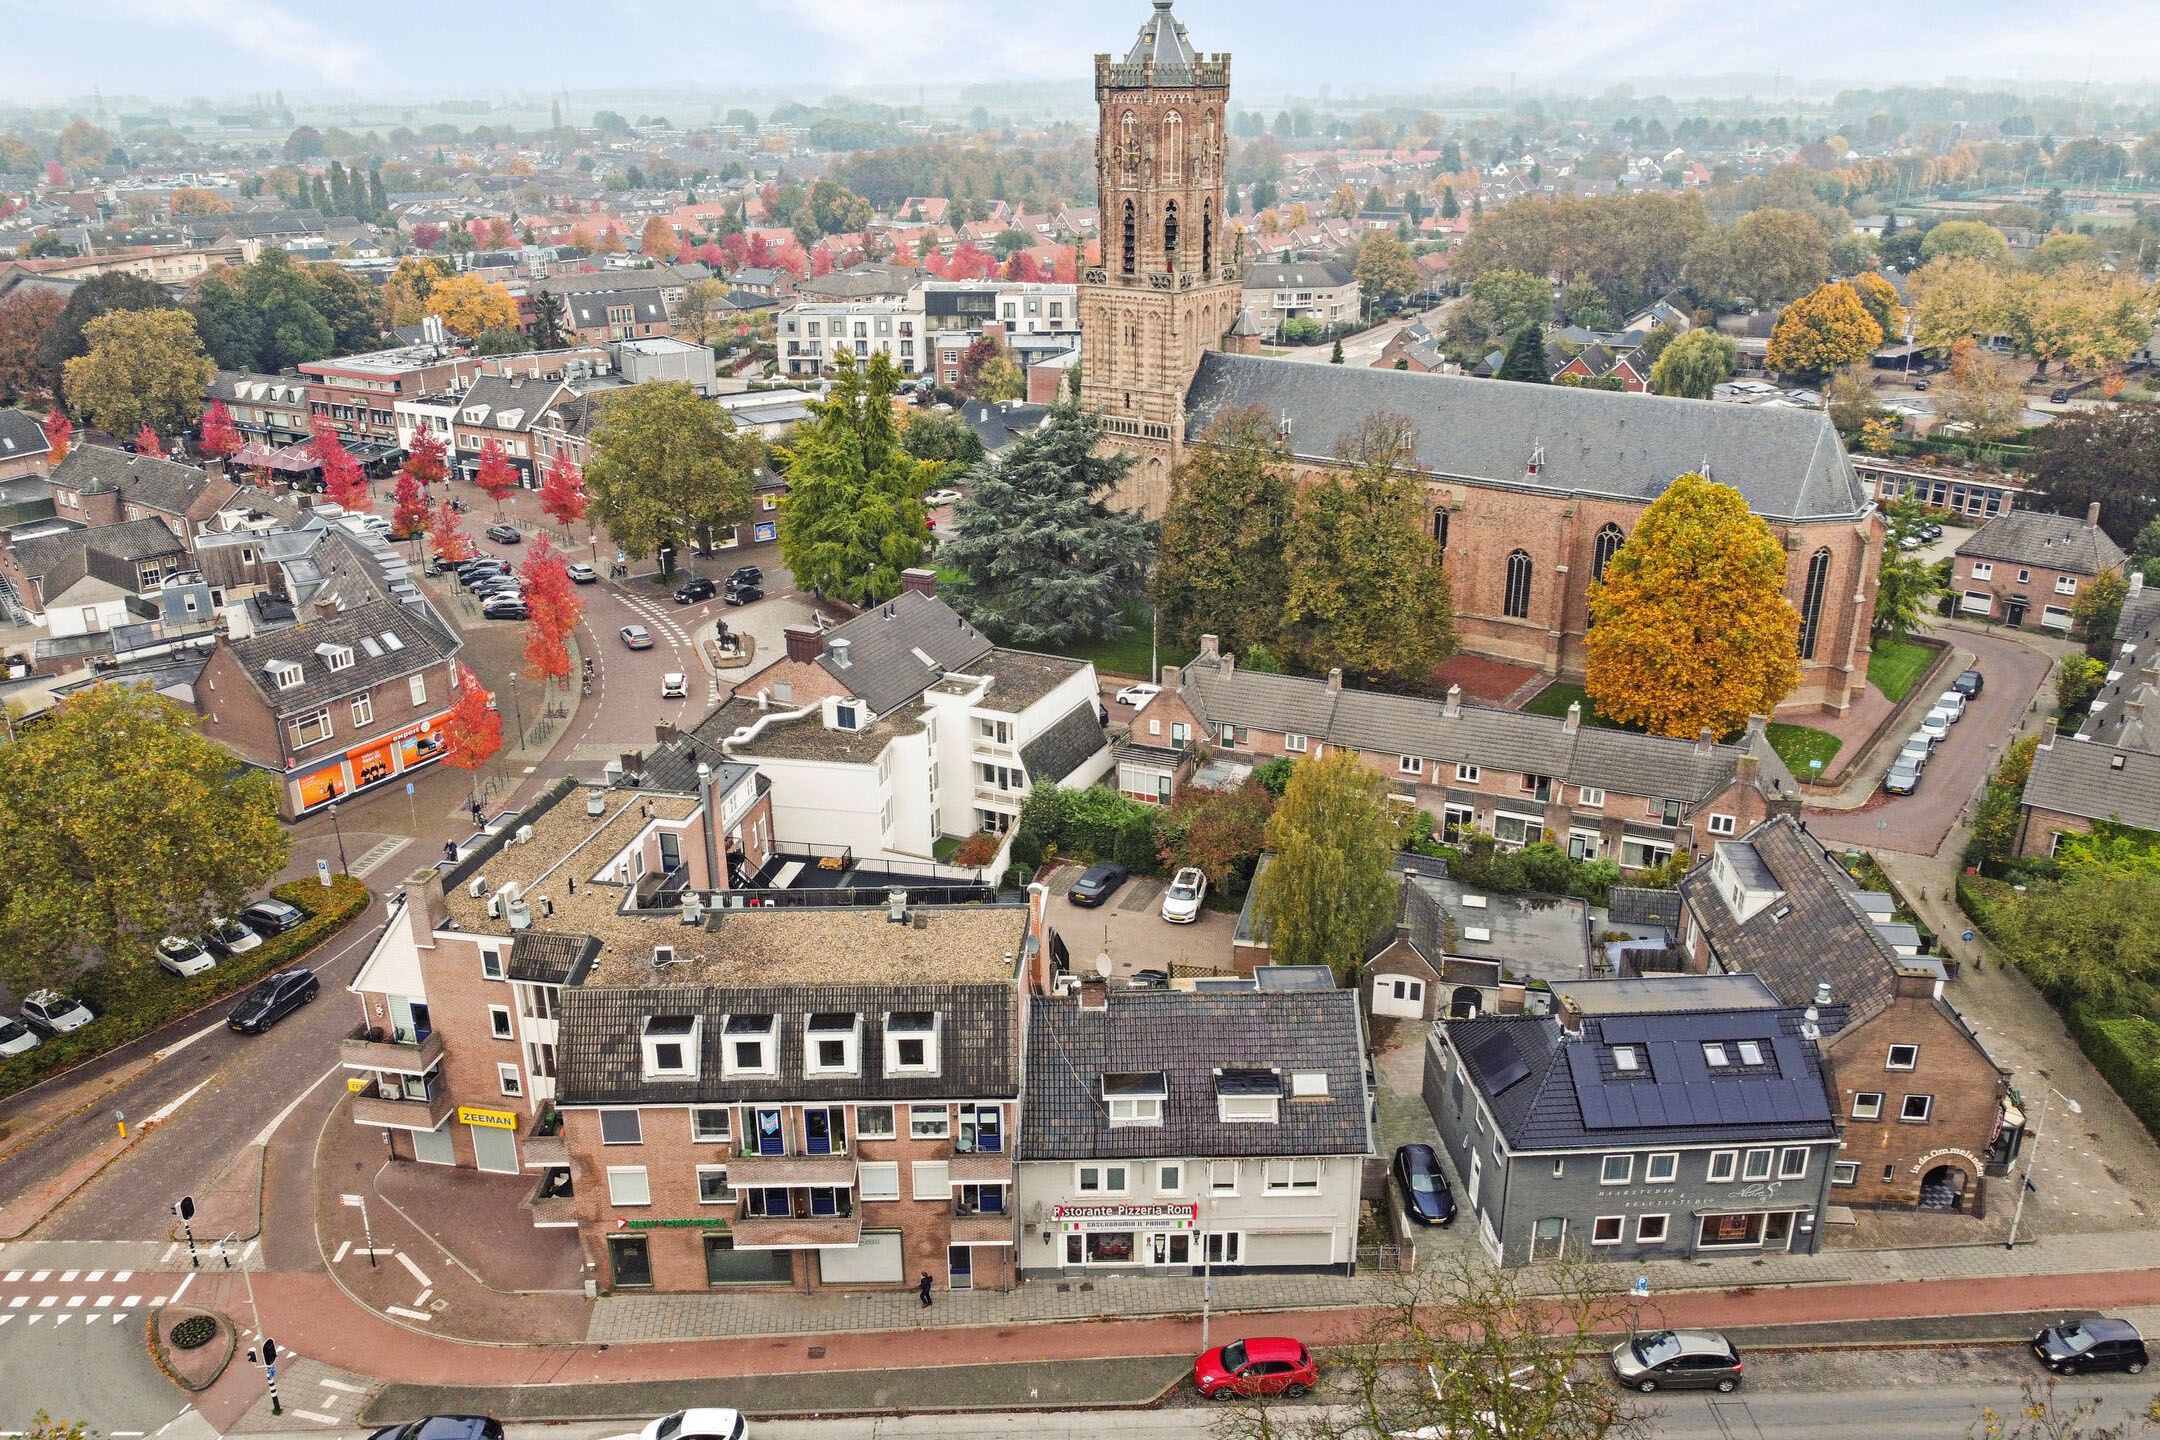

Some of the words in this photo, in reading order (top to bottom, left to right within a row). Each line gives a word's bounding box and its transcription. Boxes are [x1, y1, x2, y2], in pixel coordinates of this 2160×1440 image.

[392, 727, 420, 742] expert
[463, 1112, 512, 1126] ZEEMAN
[1598, 1187, 1674, 1197] HAARSTUDIO
[1118, 1203, 1162, 1217] Pizzeria
[1624, 1198, 1714, 1208] BEAUTYSTUDIO
